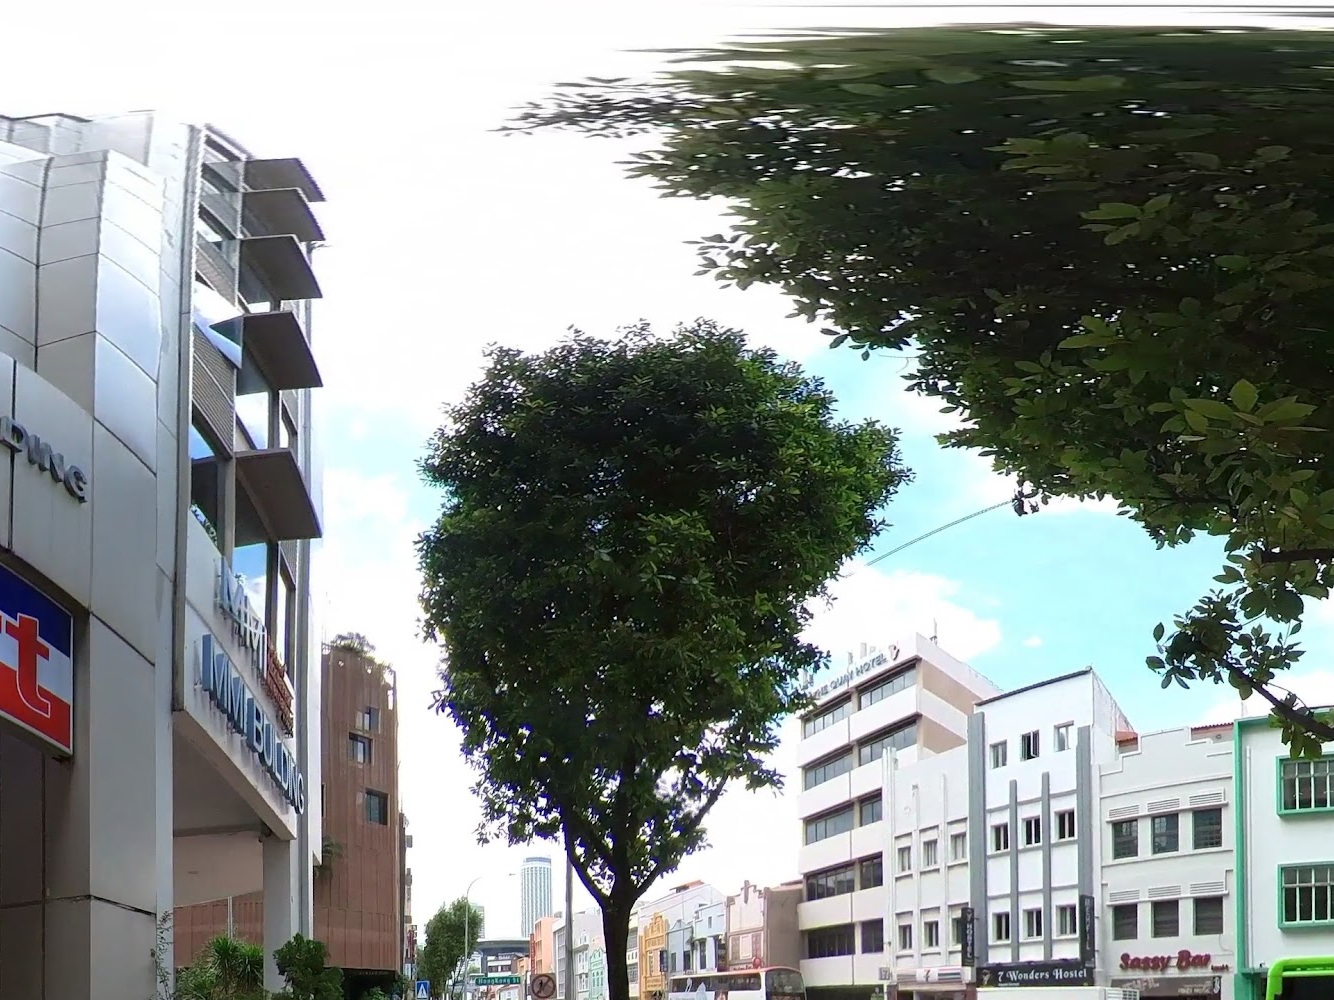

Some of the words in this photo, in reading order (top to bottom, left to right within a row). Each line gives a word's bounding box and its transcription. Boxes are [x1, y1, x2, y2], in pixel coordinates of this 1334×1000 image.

[830, 671, 854, 690] QUAY
[856, 653, 887, 677] HOTEL
[247, 697, 305, 815] BUILDING
[997, 971, 1004, 982] 7
[1006, 970, 1050, 981] Wonders
[1053, 968, 1087, 979] Hostel
[1120, 953, 1171, 971] Sassy
[1177, 950, 1211, 970] Bar
